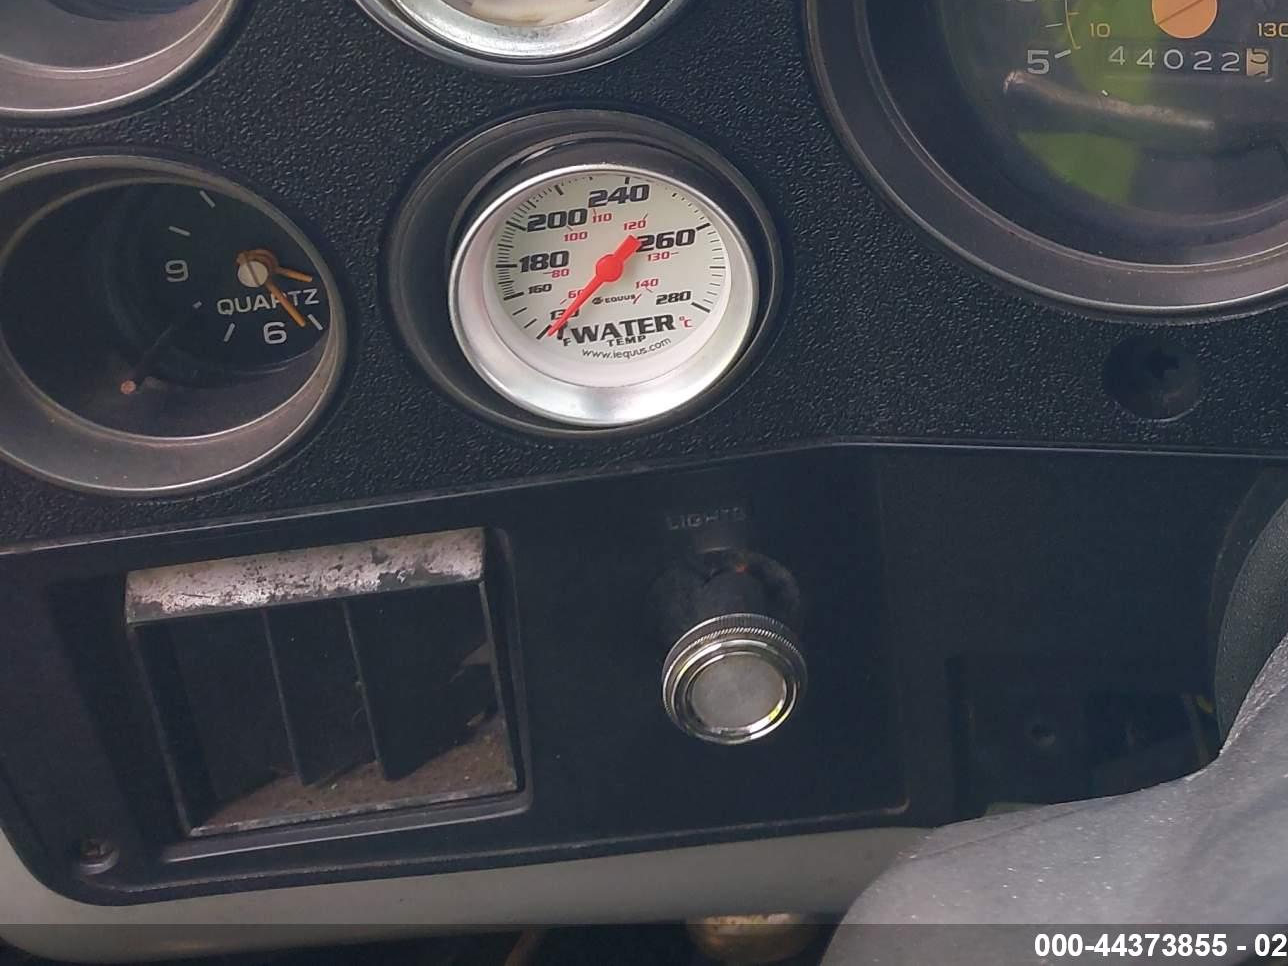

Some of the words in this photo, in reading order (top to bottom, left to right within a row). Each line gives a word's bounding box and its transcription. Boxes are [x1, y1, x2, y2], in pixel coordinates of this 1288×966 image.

[1089, 23, 1111, 38] 10
[1026, 49, 1050, 76] 5
[588, 184, 650, 208] 240
[527, 208, 588, 232] 200
[592, 212, 612, 224] 110
[623, 219, 647, 231] 120
[563, 231, 588, 242] 100
[637, 228, 696, 252] 260
[519, 250, 570, 273] 180
[647, 251, 670, 262] 130
[165, 259, 189, 282] 9
[551, 268, 570, 278] 80
[528, 284, 552, 295] 160
[635, 278, 659, 289] 140
[656, 290, 692, 306] 280
[263, 321, 287, 345] 6
[570, 314, 675, 345] WATER
[607, 334, 646, 347] TEMP
[582, 337, 672, 361] www.iequus.com
